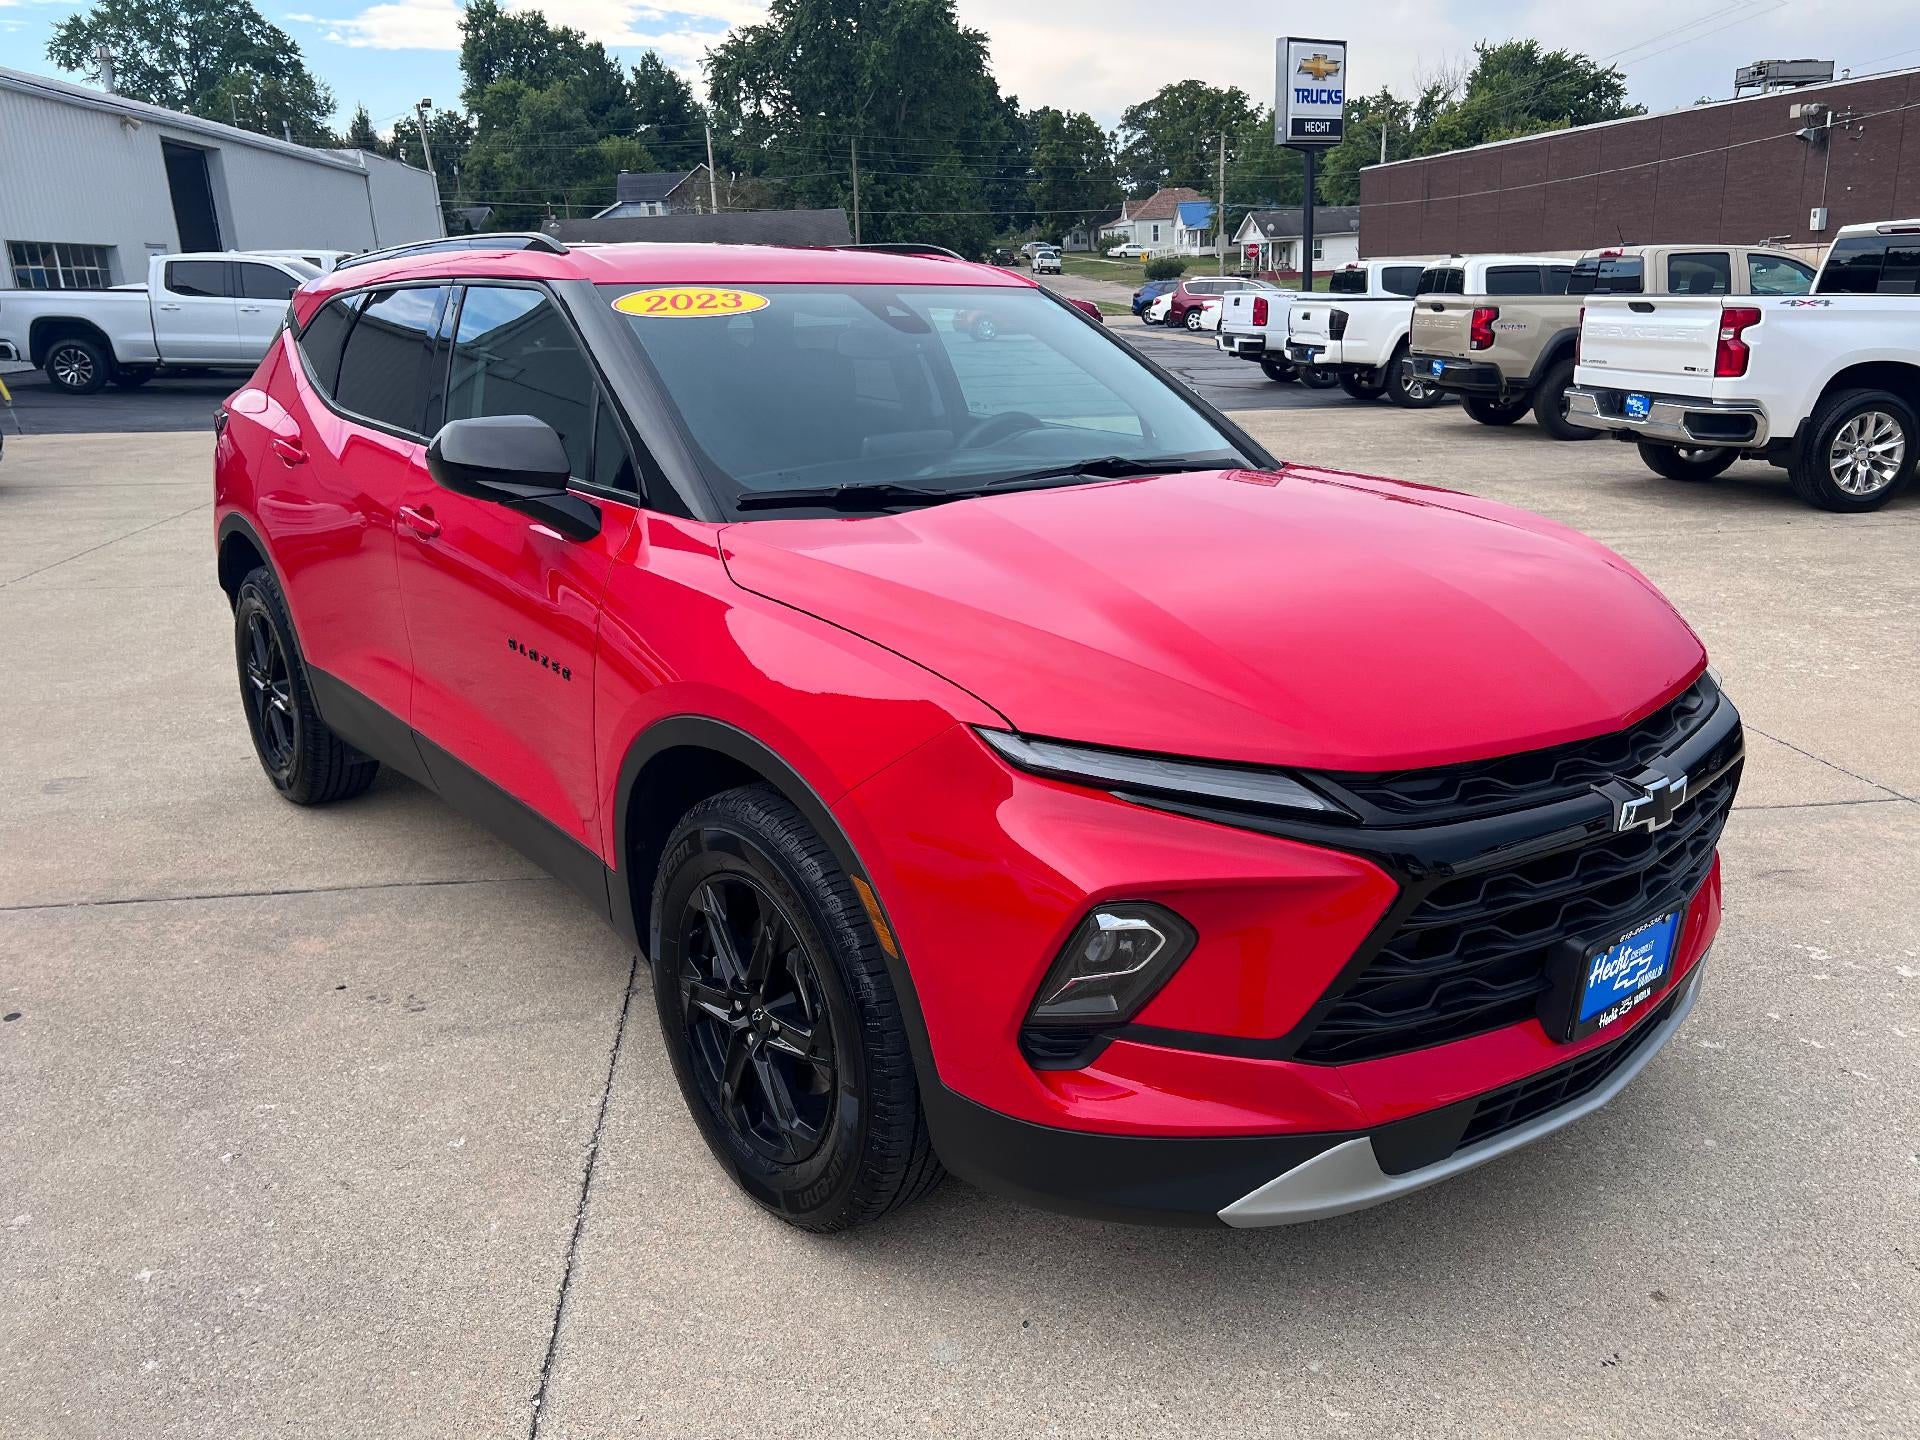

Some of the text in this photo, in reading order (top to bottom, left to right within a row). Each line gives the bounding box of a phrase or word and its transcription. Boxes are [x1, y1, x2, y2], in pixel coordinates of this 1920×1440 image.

[1294, 88, 1342, 104] TRUCKS
[1304, 121, 1331, 133] HECHT
[644, 292, 743, 313] 2023
[1585, 322, 1705, 341] CHEVROLET
[505, 638, 571, 682] BLAZER
[1588, 945, 1632, 989] Hecht
[1598, 1007, 1619, 1029] Hecht
